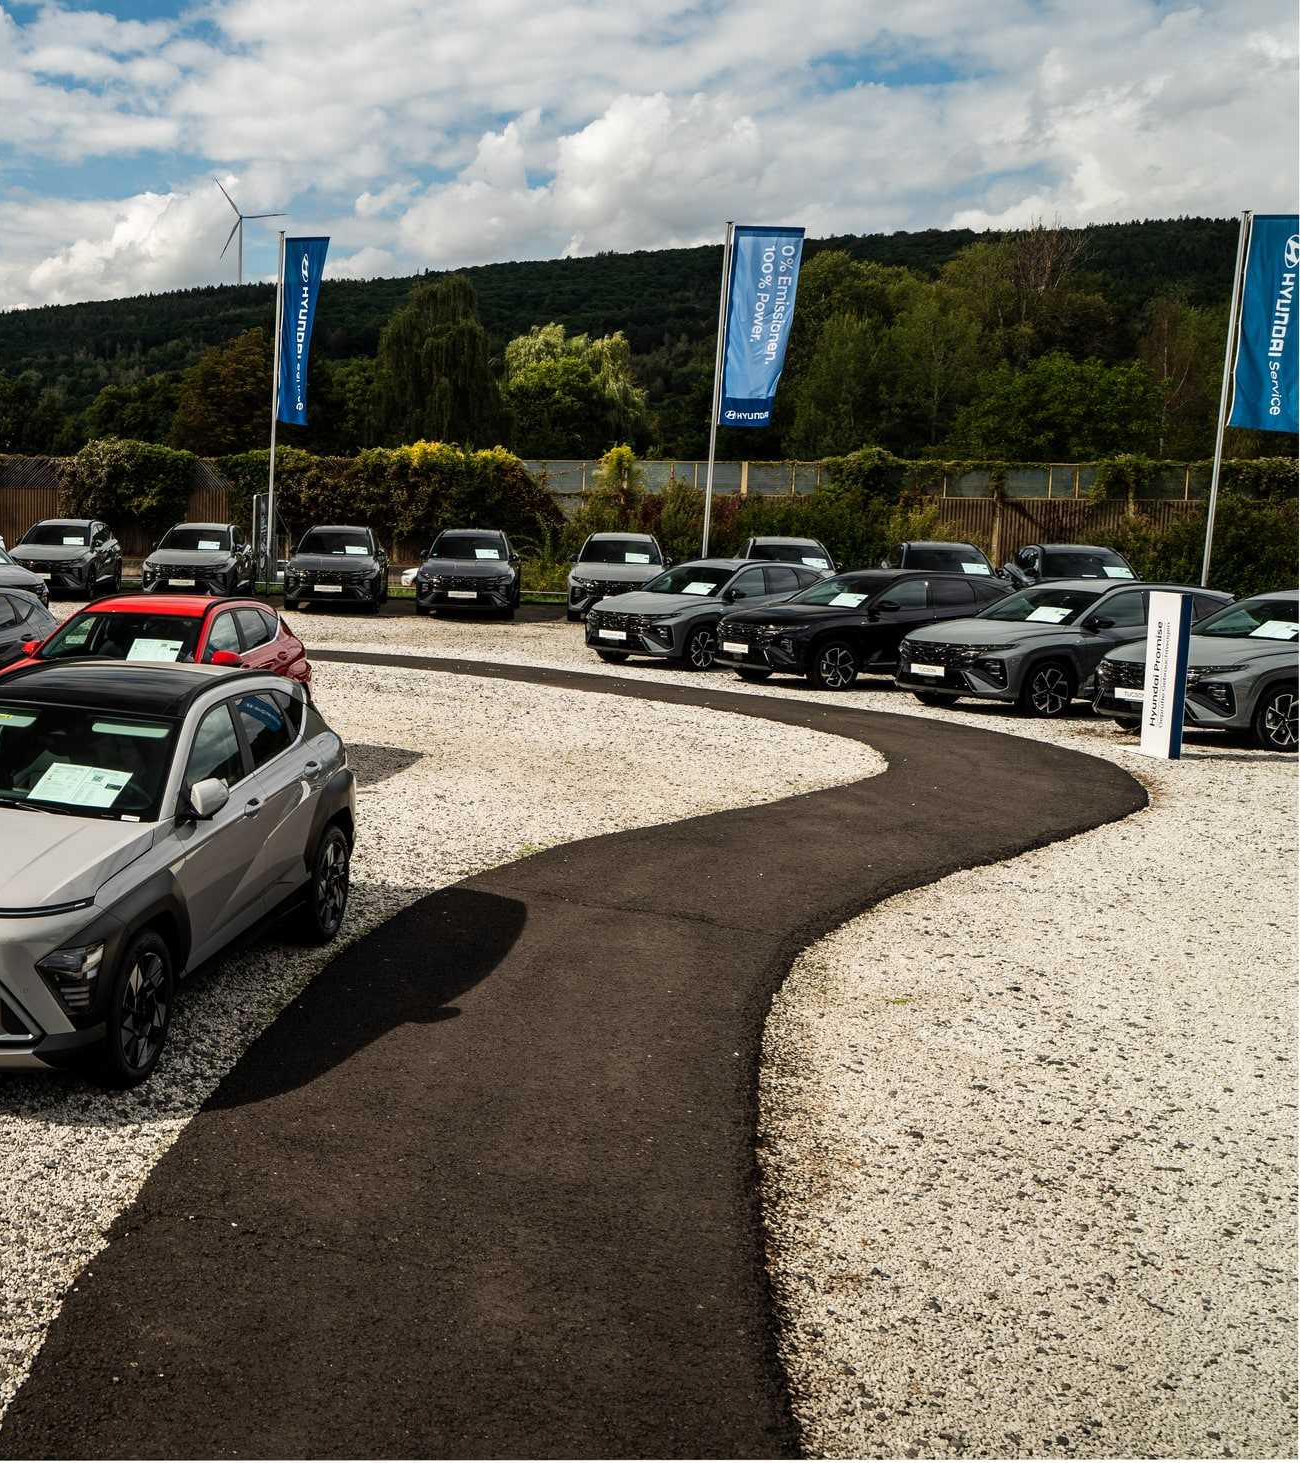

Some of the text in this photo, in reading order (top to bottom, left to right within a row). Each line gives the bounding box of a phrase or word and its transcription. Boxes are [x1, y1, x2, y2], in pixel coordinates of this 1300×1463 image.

[750, 292, 770, 343] Power.
[764, 274, 792, 365] Emissionen.
[1268, 273, 1296, 416] HYUNDAI Service
[736, 410, 769, 420] HYUNDA
[1149, 621, 1164, 727] Hyundai Promise
